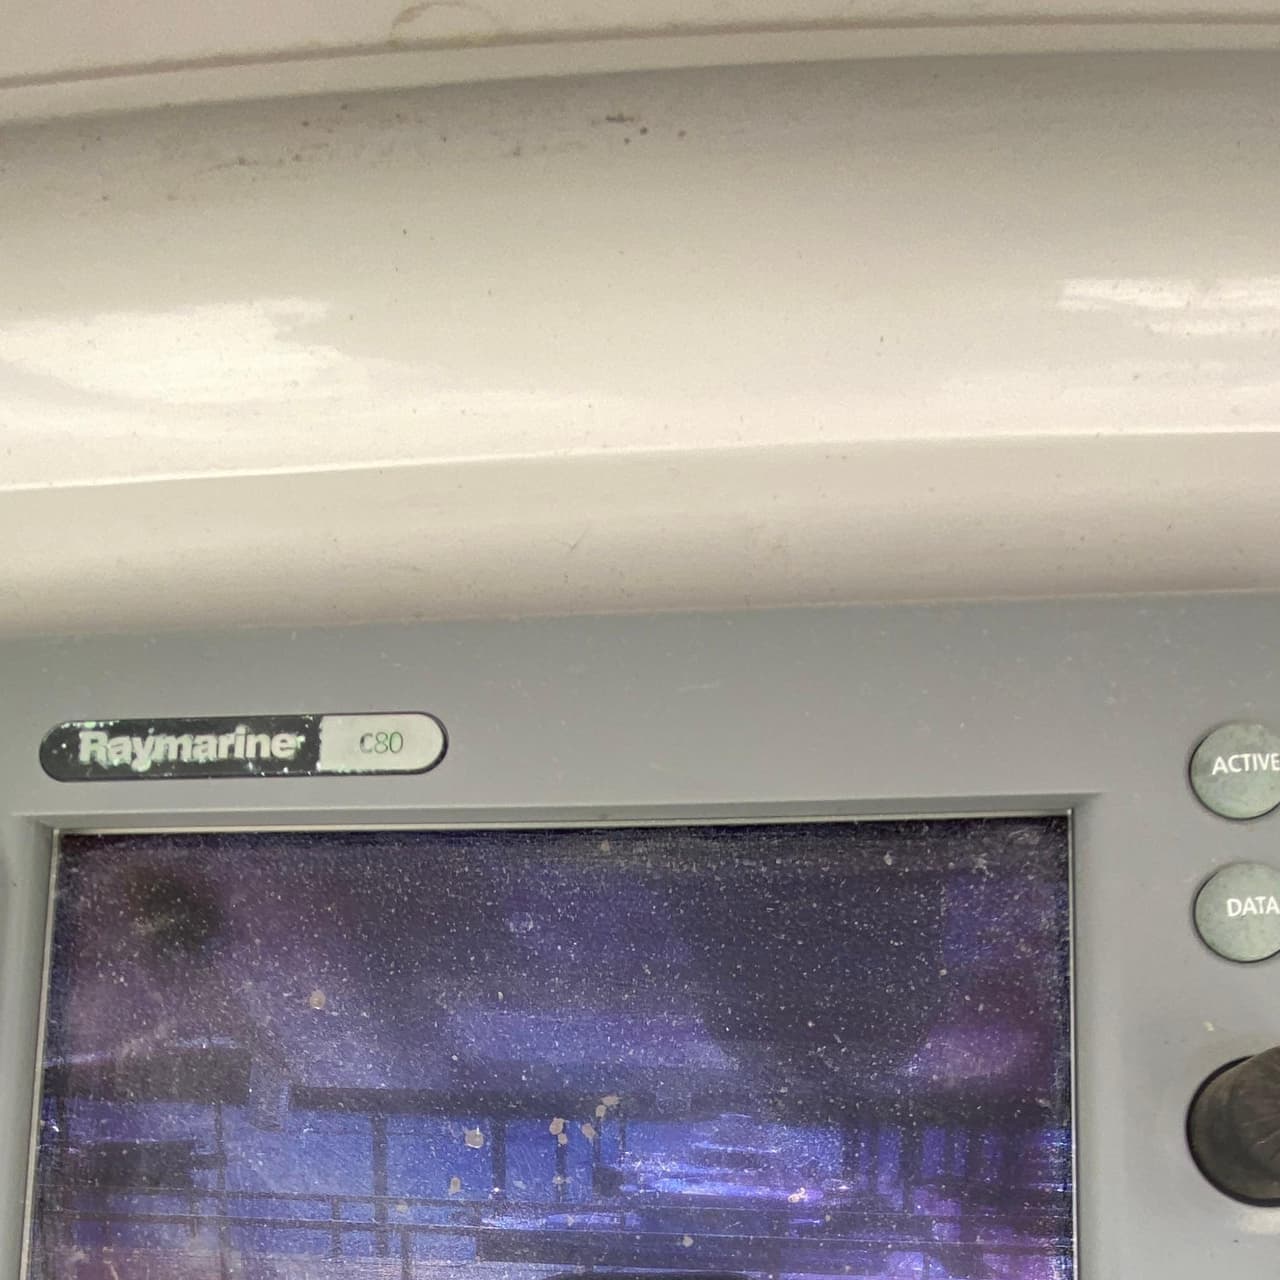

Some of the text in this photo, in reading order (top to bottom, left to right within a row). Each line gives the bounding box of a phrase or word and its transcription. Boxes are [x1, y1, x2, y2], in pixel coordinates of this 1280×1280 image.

[78, 725, 404, 772] Raymarine C80
[1211, 752, 1280, 775] ACTIVE
[1226, 895, 1280, 917] DATA
